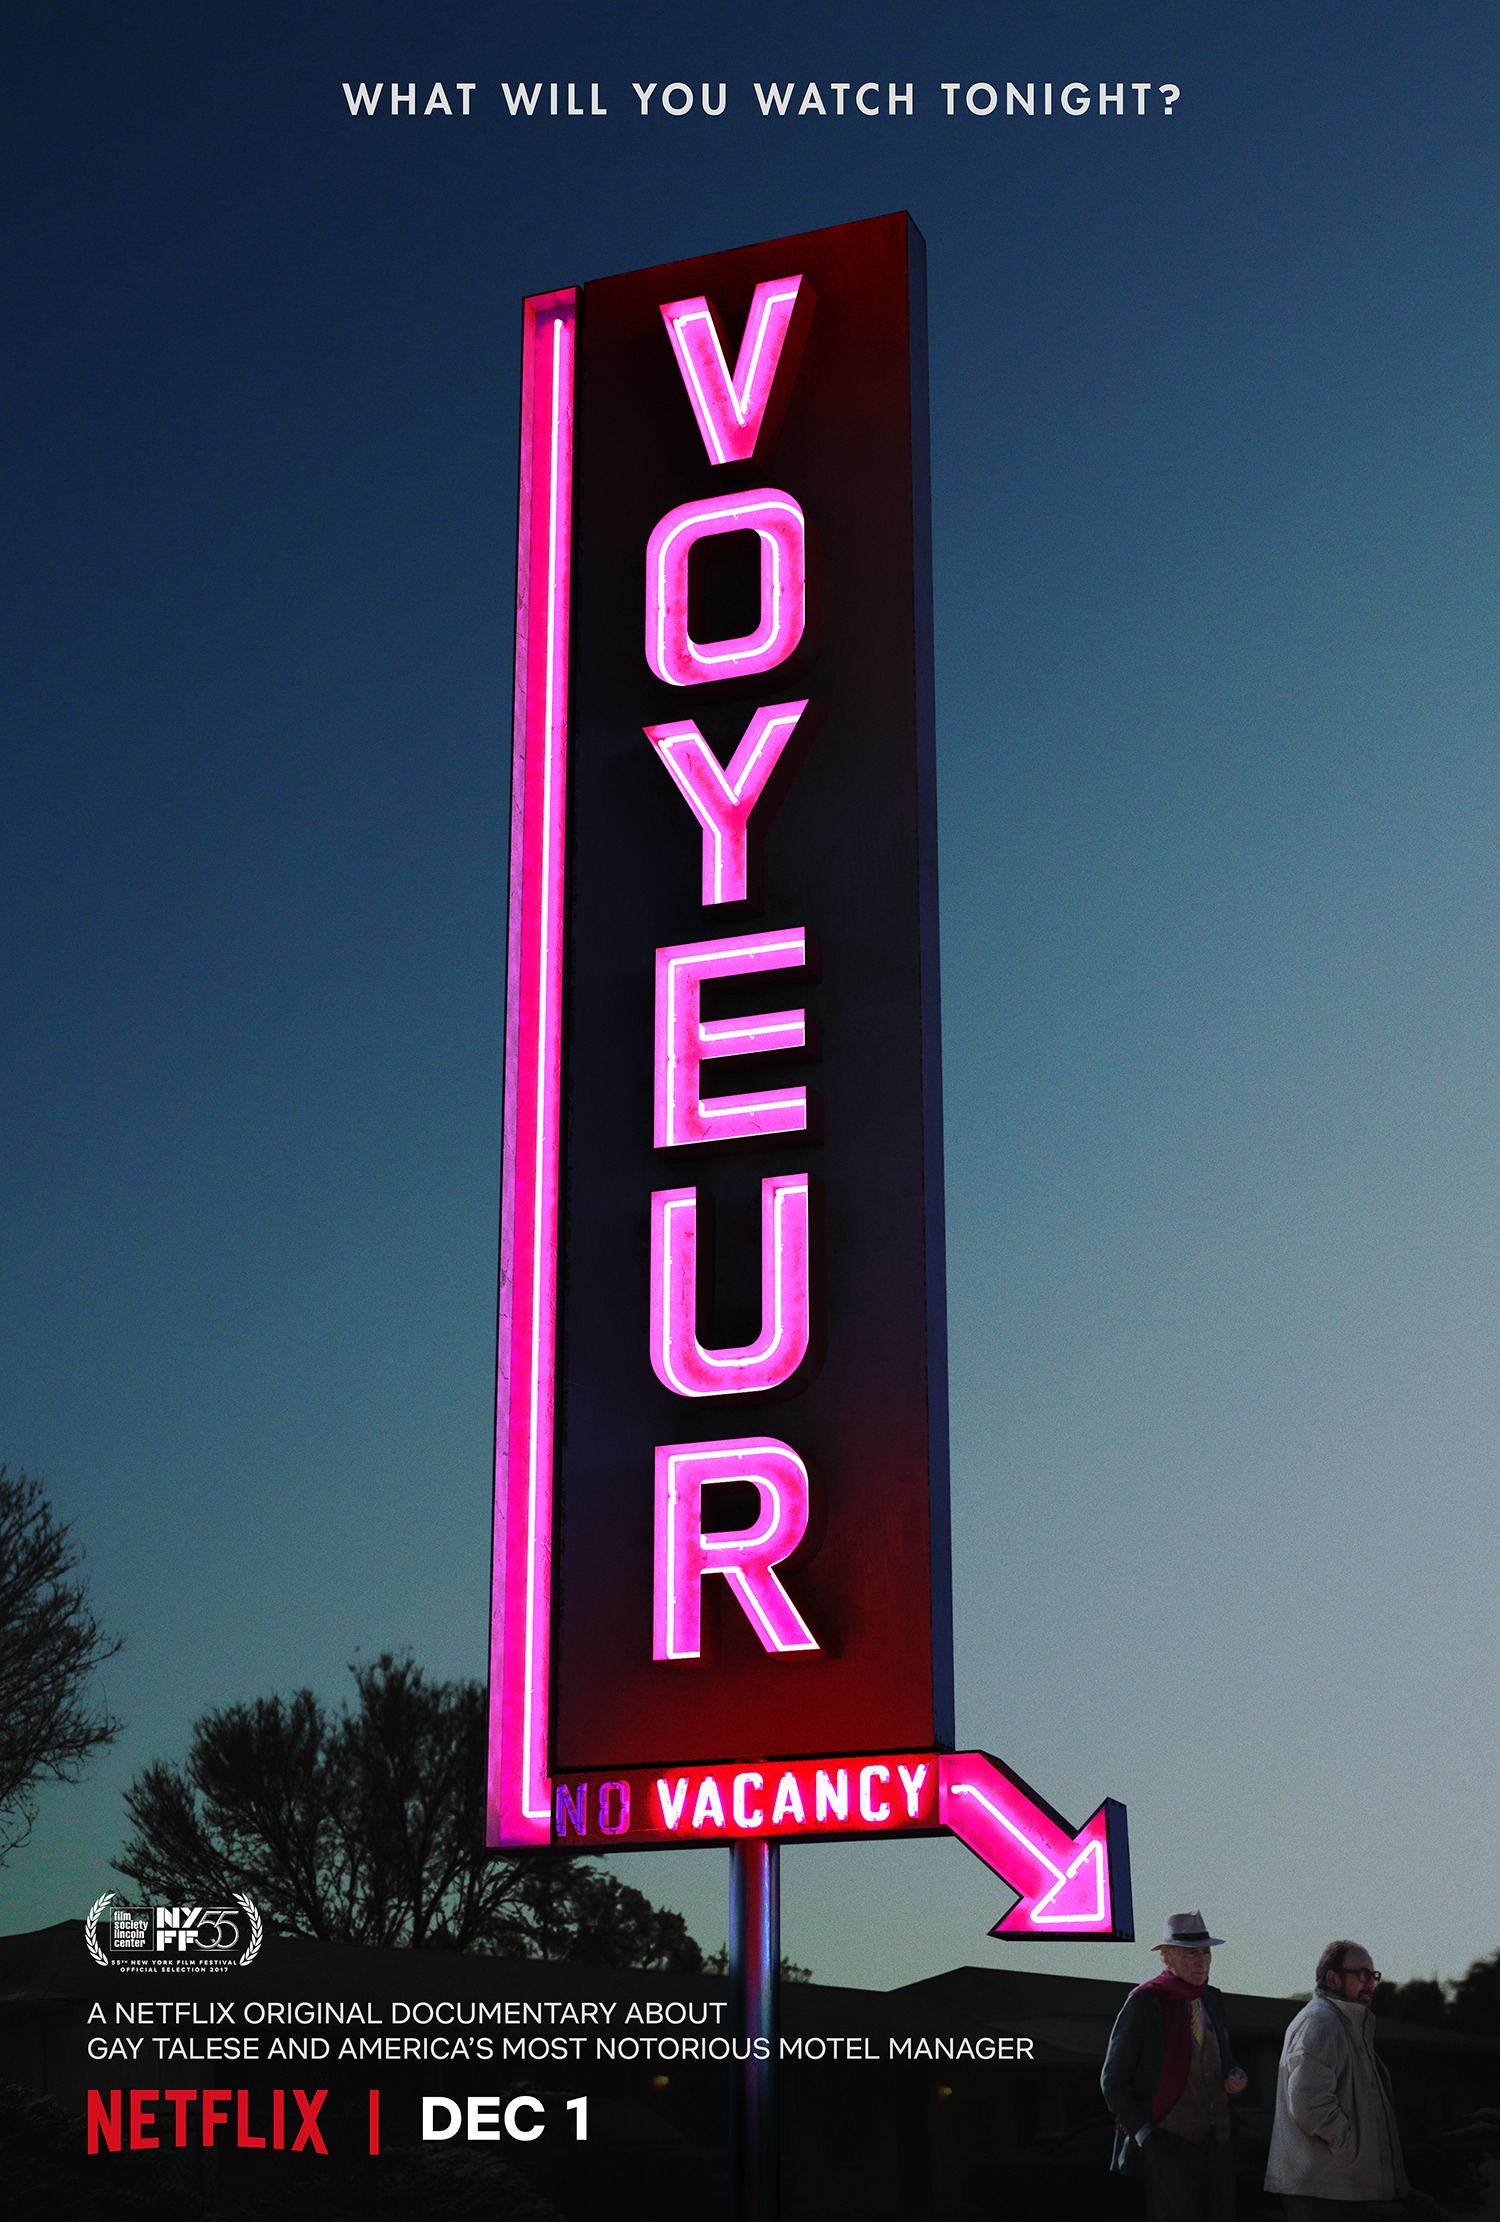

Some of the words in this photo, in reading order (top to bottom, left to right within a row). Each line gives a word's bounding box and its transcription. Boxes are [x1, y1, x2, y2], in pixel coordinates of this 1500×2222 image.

[643, 273, 820, 1661] VOYEUR
[555, 1780, 630, 1837] NO
[656, 1762, 930, 1830] VACANCY
